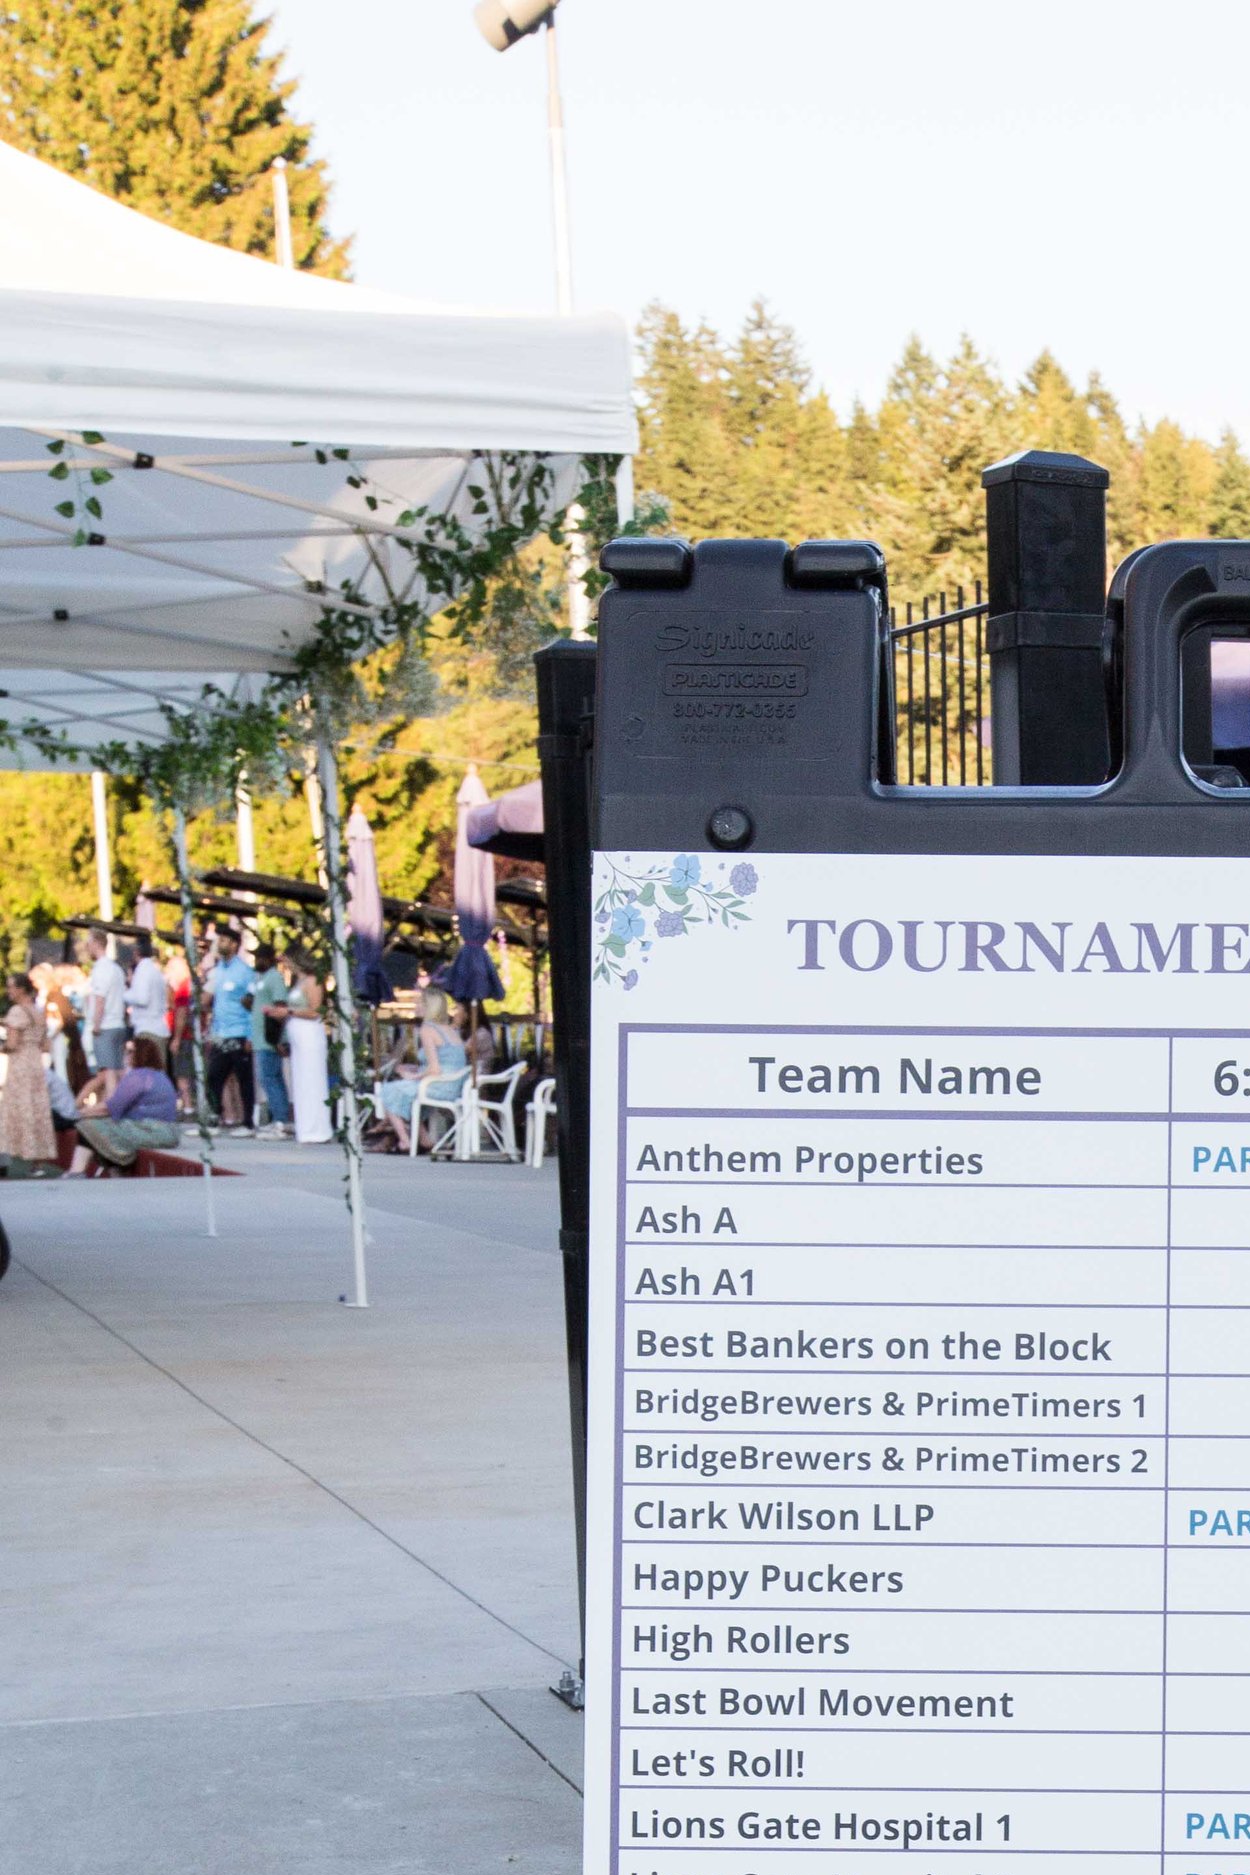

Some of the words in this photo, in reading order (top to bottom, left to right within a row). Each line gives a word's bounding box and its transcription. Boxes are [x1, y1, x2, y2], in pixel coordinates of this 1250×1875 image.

[654, 622, 815, 658] Signicade
[671, 672, 797, 689] PLASTICADE
[748, 1056, 880, 1094] Team
[900, 1057, 1042, 1096] Name
[636, 1143, 781, 1173] Anthem
[795, 1145, 983, 1183] Properties
[635, 1204, 701, 1234] Ash
[712, 1206, 738, 1234] A
[634, 1266, 700, 1296] Ash
[712, 1268, 753, 1296] A1
[636, 1329, 714, 1358] Best
[727, 1329, 874, 1360] Bankers
[885, 1337, 929, 1360] on
[941, 1331, 1002, 1361] the
[1015, 1331, 1112, 1362] Block
[635, 1388, 872, 1422] BridgeBrewers
[882, 1391, 905, 1416] &
[917, 1392, 1121, 1418] PrimeTimers
[1132, 1393, 1145, 1418] 1
[635, 1443, 872, 1478] BridgeBrewers
[881, 1446, 905, 1472] &
[916, 1447, 1121, 1473] PrimeTimers
[1130, 1448, 1148, 1473] 2
[634, 1500, 728, 1530] Clark
[738, 1501, 859, 1531] Wilson
[873, 1503, 934, 1531] LLP
[634, 1563, 750, 1601] Happy
[761, 1563, 904, 1594] Puckers
[633, 1624, 713, 1662] High
[727, 1624, 850, 1655] Rollers
[633, 1687, 707, 1715] Last
[719, 1686, 805, 1716] Bowl
[819, 1688, 1014, 1718] Movement
[632, 1748, 715, 1777] Let's
[728, 1748, 804, 1778] Roll!
[631, 1810, 725, 1839] Lions
[737, 1811, 821, 1840] Gate
[834, 1812, 983, 1849] Hospital
[996, 1814, 1010, 1842] 1
